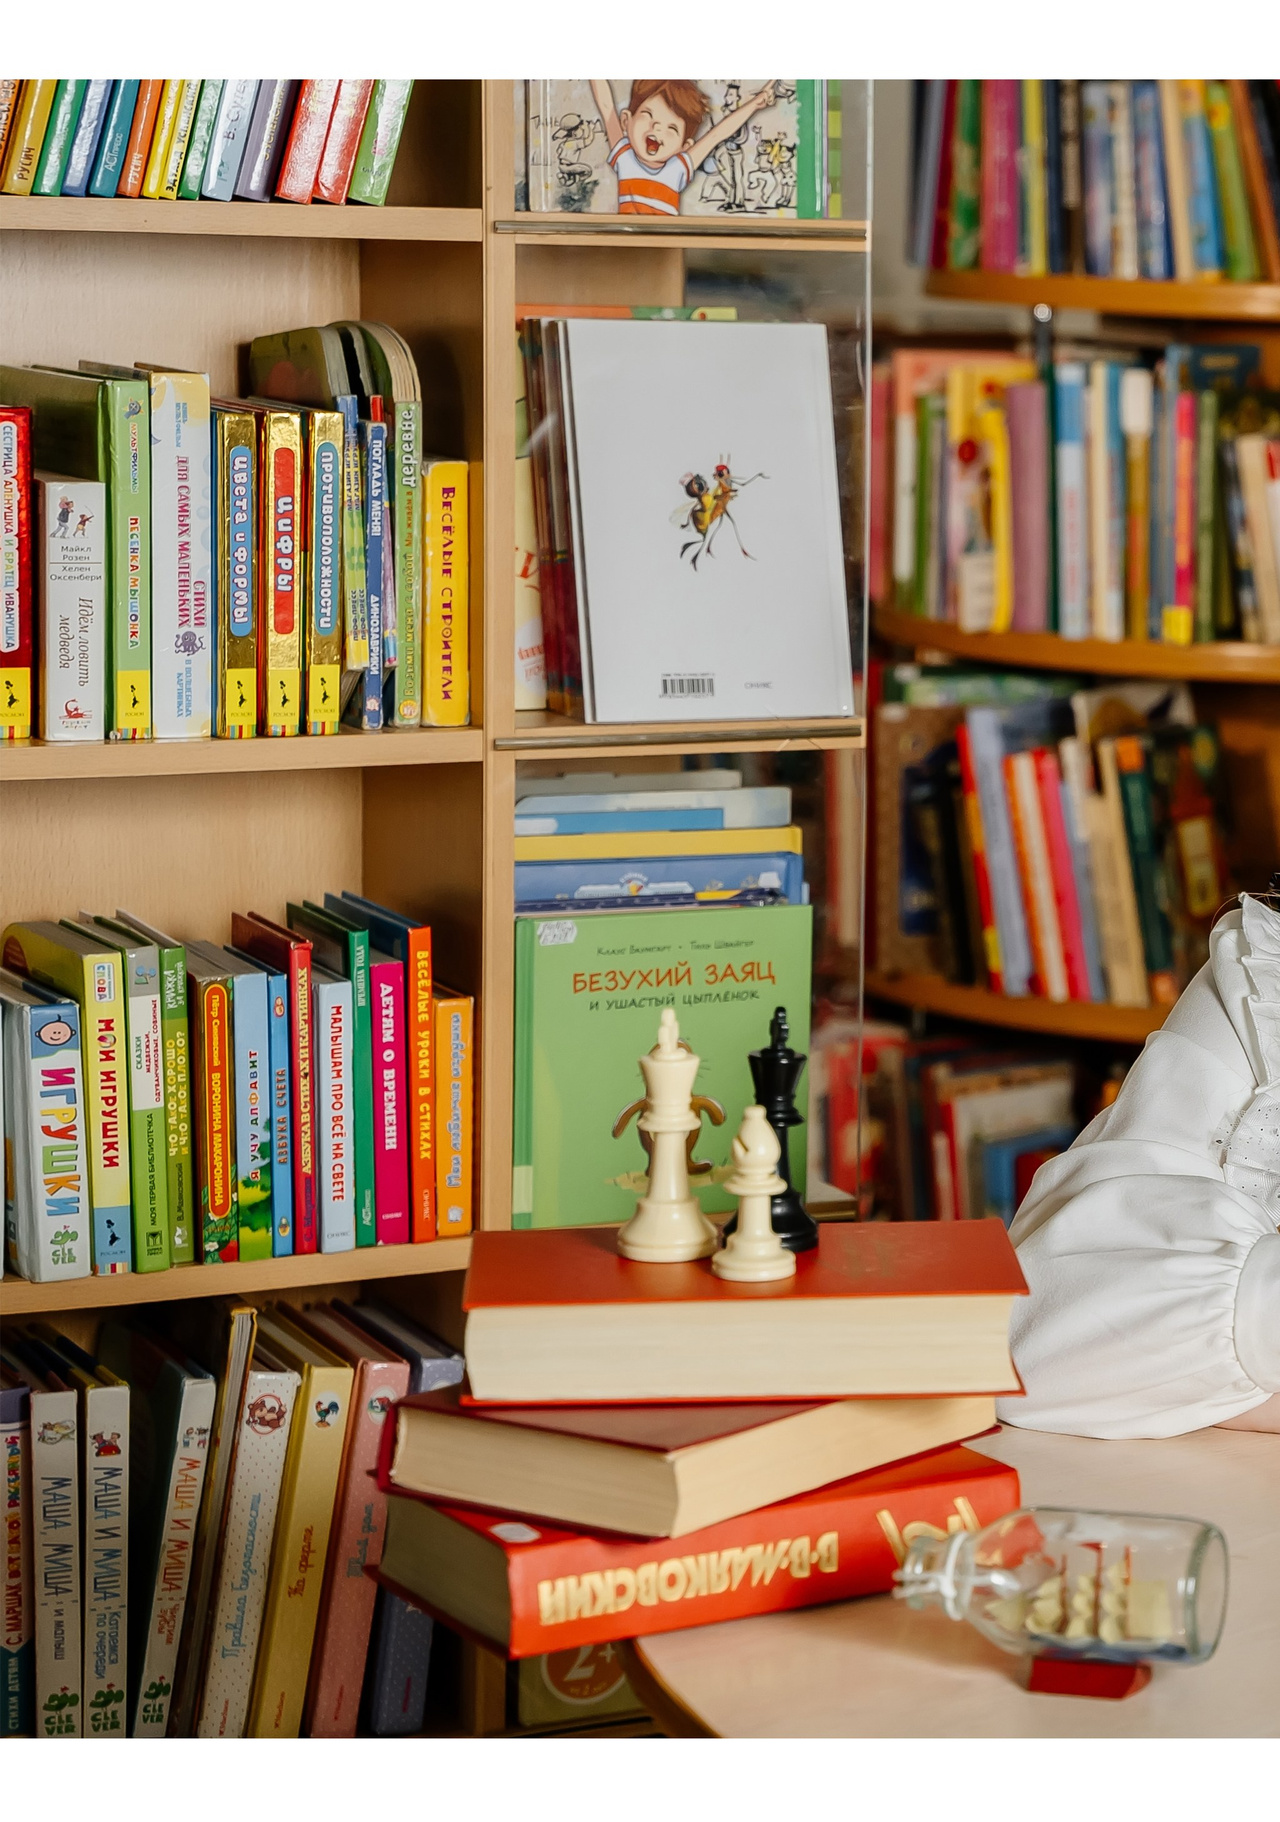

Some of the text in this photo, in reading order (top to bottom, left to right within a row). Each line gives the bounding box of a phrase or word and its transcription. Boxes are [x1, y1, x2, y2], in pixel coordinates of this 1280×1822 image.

[17, 146, 35, 180] РУСИЧ
[129, 152, 143, 184] РУСИЧ
[166, 152, 184, 192] ЭДУАРД
[2, 425, 15, 476] СЕСТРИЦА
[129, 422, 139, 494] МУЛЬТФИЛЬМЫ
[400, 410, 417, 488] деревне
[370, 439, 383, 536] ПОГЛАДЬ МЕНЯ!
[4, 539, 13, 547] И
[176, 456, 191, 628] ДЛЯ САМЫХ МАЛЕНЬКИХ
[276, 496, 293, 591] ЦИФРЫ
[319, 451, 335, 629] ПРОТИВОПОЛОЖНОСТИ
[404, 532, 413, 547] Мы
[2, 551, 15, 588] БРАТЕЦ
[128, 516, 141, 649] ПЕСЕНКА МЫШОНКА
[4, 592, 16, 649] ИВАНУШКА
[193, 580, 206, 627] СТИХИ
[401, 553, 415, 696] Возьми меня с собой
[57, 615, 72, 669] медведя
[77, 598, 93, 687] Идём ловить
[369, 594, 381, 675] ДИНОЗАВРИКИ
[440, 587, 454, 700] СТРОИТЕЛИ
[176, 672, 184, 718] КАРТИНКАХ
[184, 667, 192, 718] ВОЛШЕБНЫХ
[96, 964, 108, 1001] СЛОВА
[164, 970, 177, 1009] КНИЖКА
[211, 994, 222, 1018] Пётр
[573, 961, 776, 994] БЕЗУХИЙ ЗАЯЦ
[589, 1000, 599, 1011] И
[606, 993, 676, 1010] УШАСТЫЙ
[298, 967, 309, 1050] КАРТИНКАХ
[135, 1036, 144, 1070] СКАЗКИ
[151, 1000, 162, 1102] ОДУВАНЧИКОВЫЕ, СОВИНЫЕ
[176, 1031, 188, 1082] ПЛОХО?
[379, 983, 397, 1150] ДЕТЯМ О ВРЕМЕНИ
[416, 950, 431, 1159] ВЕСЁЛЫЕ УРОКИ В СТИХАХ
[97, 1018, 119, 1168] МОИ ИГРУШКИ
[166, 1039, 179, 1156] ЧТО ТАКОЕ ХОРОШО
[178, 1084, 188, 1119] ТАКОЕ
[211, 1072, 222, 1131] ВОРОНИНА
[248, 1050, 259, 1180] Я УЧУ АЛФАВИТ
[330, 1005, 347, 1202] МАЛЫШАМ ПРО ВСЁ НА СВЕТЕ
[40, 1066, 81, 1216] ИГРУШКИ
[178, 1121, 189, 1146] ЧТО
[276, 1115, 288, 1164] АЗБУКА
[302, 1122, 311, 1174] АЗБУКА
[146, 1113, 157, 1226] МОЯ ПЕРВАЯ БИБЛИОТЕЧКА
[175, 1162, 185, 1221] В.Маяковский
[213, 1133, 223, 1206] МАКАРОНИНА
[40, 1477, 76, 1597] МАША, МИША
[92, 1467, 123, 1601] МАША И МИША
[161, 1457, 202, 1593] МАША И МИША
[288, 1525, 316, 1598] На ферме
[5, 1582, 22, 1632] МАРШАК
[164, 1603, 181, 1646] Чистим
[221, 1595, 247, 1659] Правила
[93, 1612, 107, 1680] по очереди
[108, 1611, 121, 1665] Катаемся
[7, 1657, 21, 1730] СТИХИ ДЕТЯМ
[44, 1714, 74, 1726] CLE
[90, 1710, 118, 1722] CLE
[142, 1703, 165, 1714] CLE
[142, 1713, 164, 1724] VER
[45, 1724, 76, 1736] VER
[92, 1721, 120, 1733] VER
